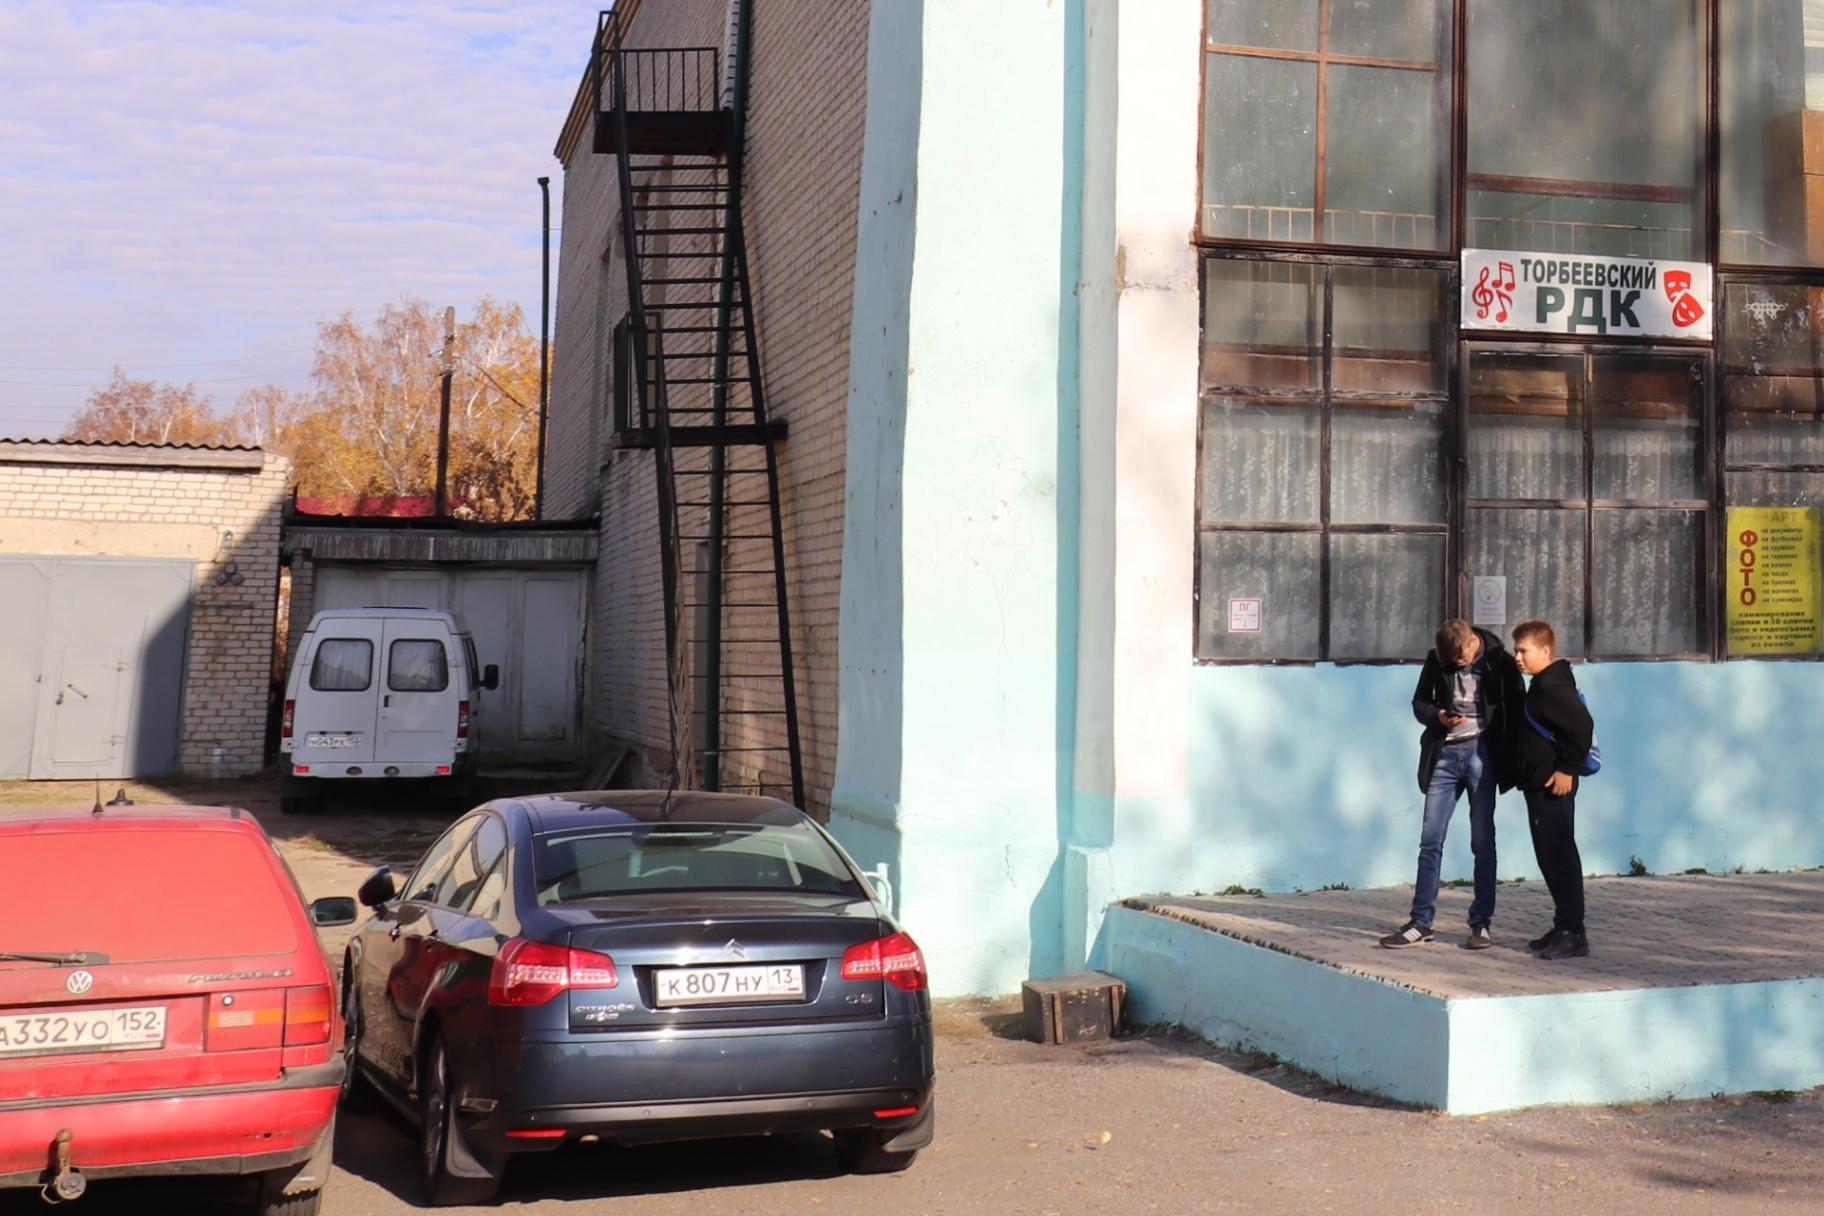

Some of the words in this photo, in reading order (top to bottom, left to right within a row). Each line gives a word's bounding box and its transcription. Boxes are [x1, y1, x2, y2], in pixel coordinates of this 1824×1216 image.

[1521, 259, 1656, 290] ТОРБЕЕВСКИЙ
[1536, 286, 1641, 334] РДК
[1771, 512, 1798, 522] АРТ
[1739, 530, 1758, 606] ФОТО
[773, 968, 792, 984] 13
[116, 1011, 157, 1031] 152
